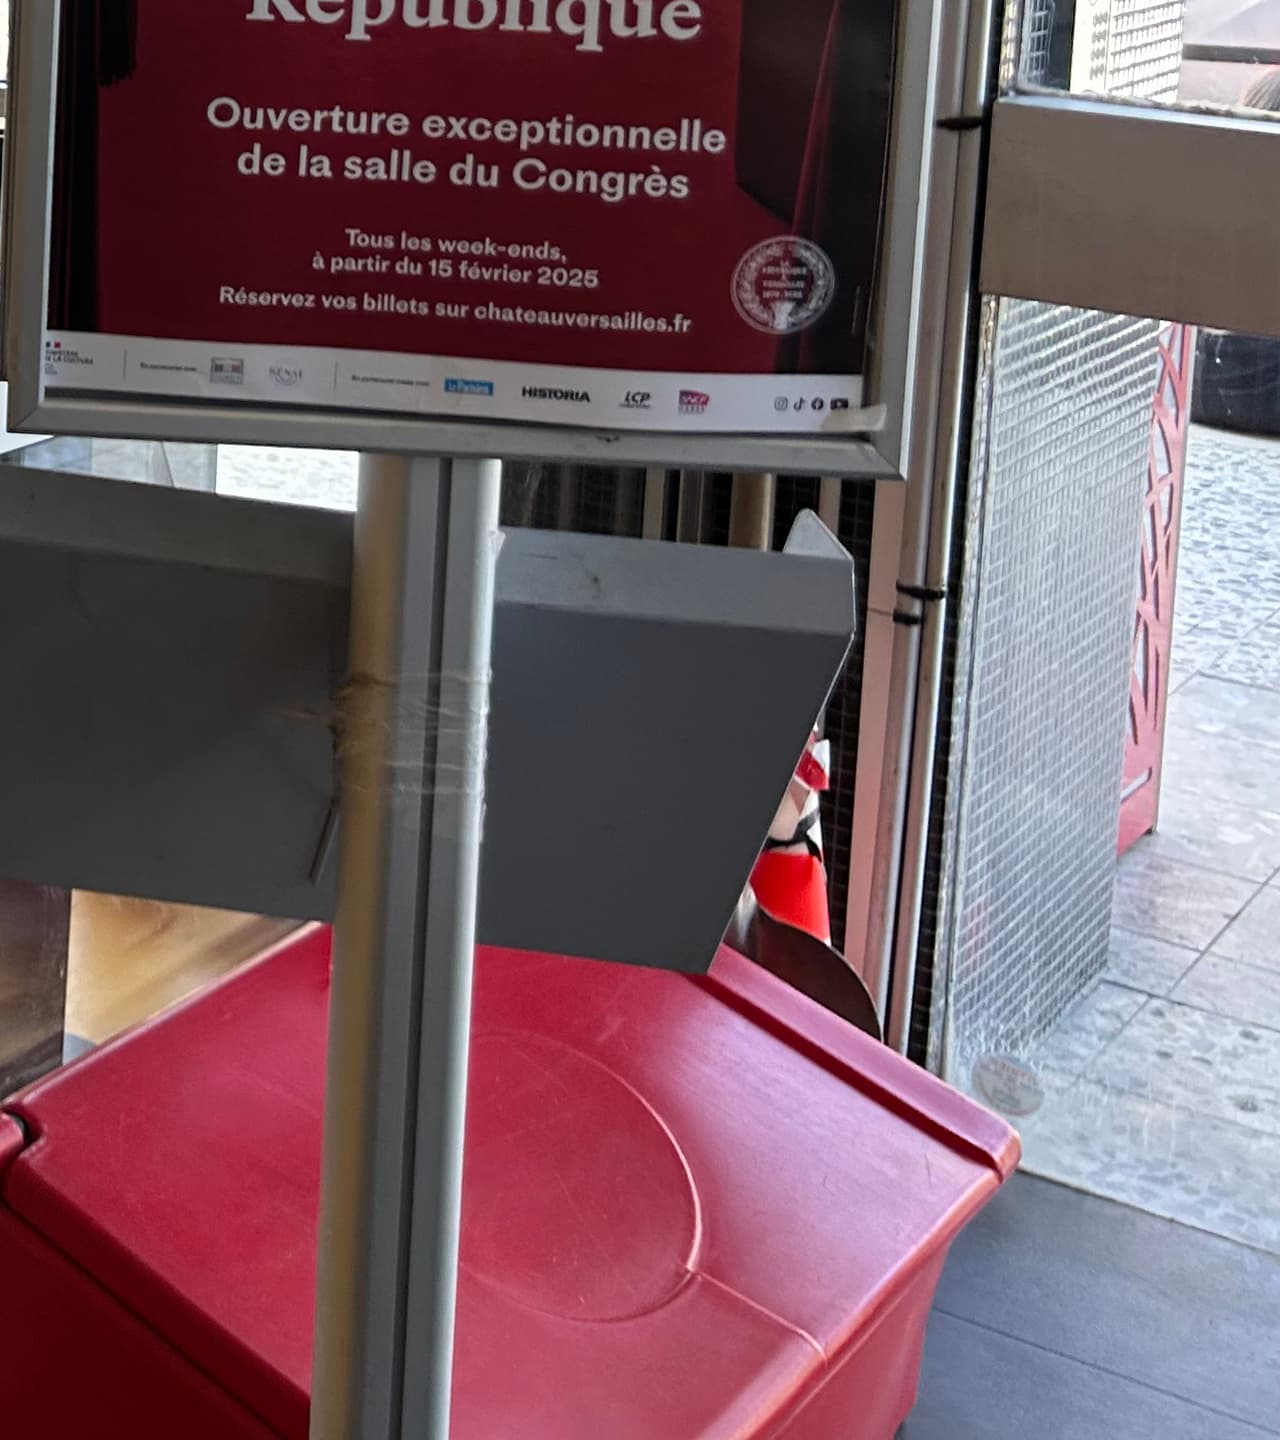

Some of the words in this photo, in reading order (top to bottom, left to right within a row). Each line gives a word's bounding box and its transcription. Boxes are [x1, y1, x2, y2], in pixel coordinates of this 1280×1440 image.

[206, 96, 410, 137] Ouverture
[422, 114, 727, 153] exceptionnelle
[237, 143, 286, 176] de
[297, 144, 332, 179] la
[343, 148, 437, 184] salle
[448, 153, 499, 189] du
[512, 157, 690, 203] Congrès
[345, 227, 395, 250] Tous
[400, 230, 432, 252] les
[438, 235, 568, 263] week-ends,
[311, 250, 326, 271] à
[331, 254, 390, 276] partir
[394, 255, 423, 276] du
[428, 258, 453, 278] 15
[458, 260, 532, 284] février
[536, 266, 600, 289] 2025
[219, 285, 316, 308] Réservez
[320, 292, 357, 311] vos
[362, 291, 429, 316] billets
[434, 301, 469, 318] sur
[474, 302, 692, 333] chateauversailles.fr
[522, 386, 591, 403] HISTORIA
[624, 391, 651, 404] LCP
